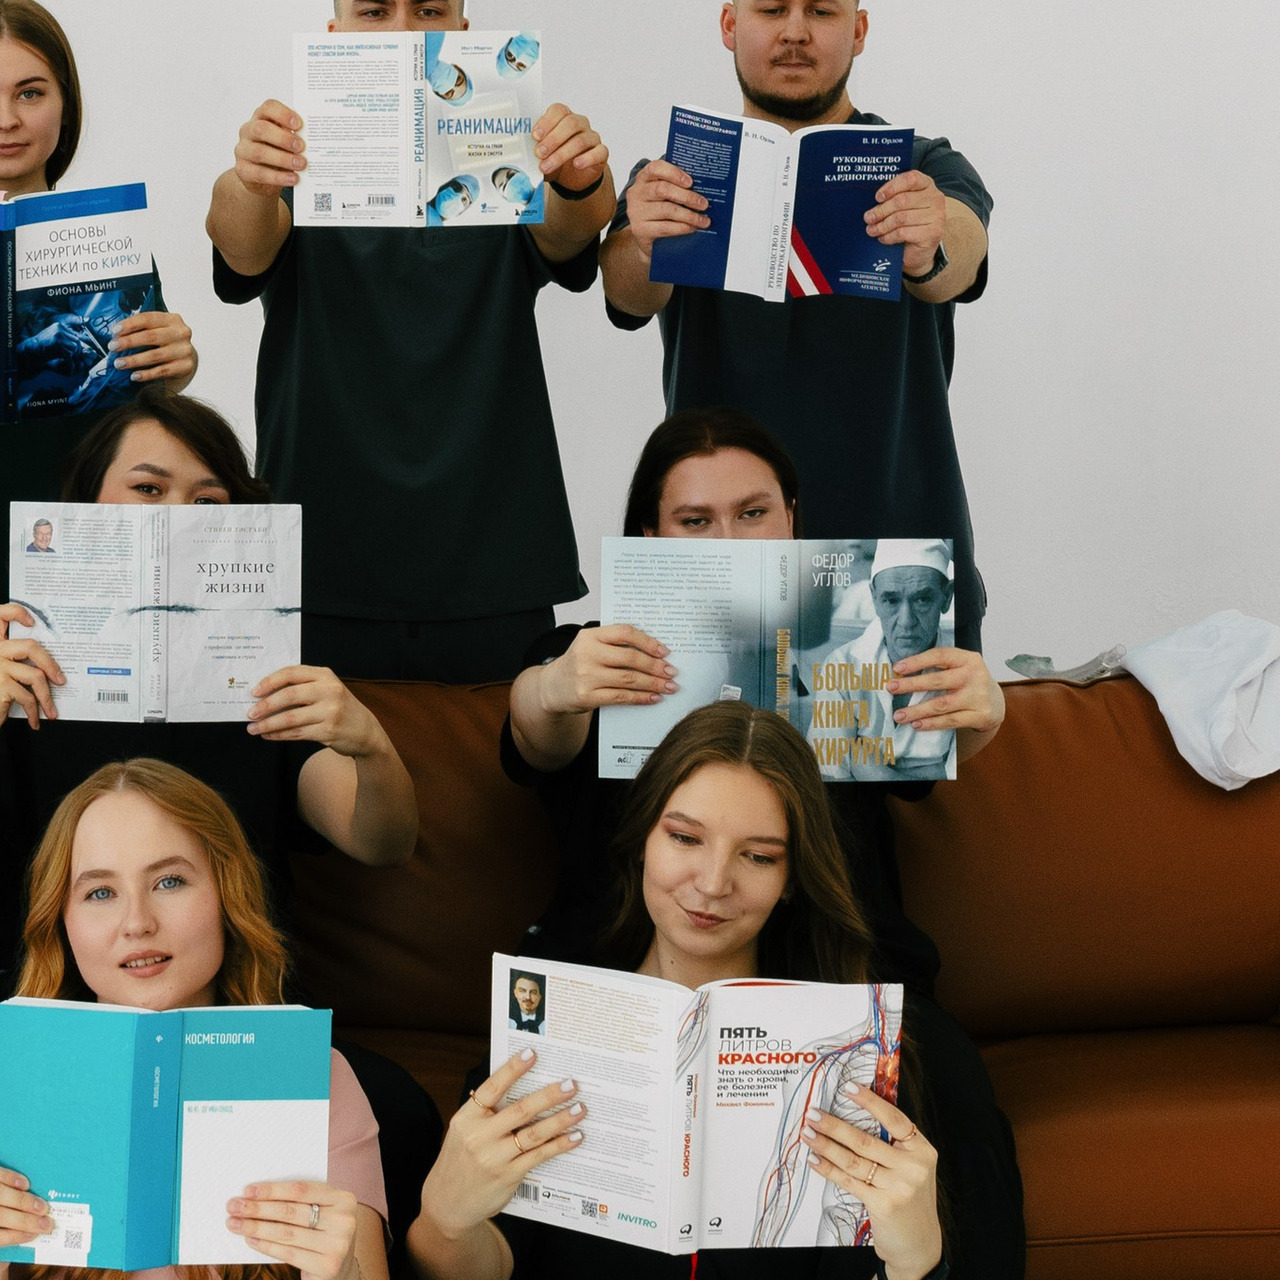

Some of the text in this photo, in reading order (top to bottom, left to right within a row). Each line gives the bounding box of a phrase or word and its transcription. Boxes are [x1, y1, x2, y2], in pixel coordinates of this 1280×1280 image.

[414, 88, 425, 163] РЕАНИМАЦИЯ
[676, 111, 712, 124] РУКОВОДСТВО
[437, 117, 532, 135] РЕАНИМАЦИЯ
[881, 137, 903, 145] Орлов
[833, 155, 901, 164] РУКОВОДСТВО
[854, 164, 900, 173] ЭЛЕКТРО-
[49, 225, 107, 243] ОСНОВЫ
[25, 236, 133, 263] ХИРУРГИЧЕСКОЙ
[18, 253, 141, 280] ТЕХНИКИ по КИРКУ
[47, 280, 117, 297] ФИОНА МЬИНТ
[197, 562, 275, 577] хрупкие
[811, 553, 855, 570] ФЕДОР
[152, 565, 161, 604] жизни
[205, 583, 265, 593] жизни
[812, 572, 852, 588] УГЛОВ
[151, 612, 161, 662] хрупкие
[812, 662, 901, 692] БОЛЬША
[813, 700, 870, 729] КНИГА
[813, 737, 896, 766] ХИРУРГА
[185, 1032, 255, 1045] КОСМЕТОЛОГИЯ
[720, 1026, 768, 1039] ПЯТЬ
[718, 1039, 792, 1053] ЛИТРОВ
[718, 1052, 817, 1065] КРАСНОГО
[738, 1067, 799, 1076] необходимо
[732, 1082, 778, 1091] болезнях
[756, 1076, 789, 1084] крови,
[682, 1074, 694, 1178] ПЯТЬ ЛИТРОВ КРАСНОГО
[617, 1212, 658, 1229] INVITRO
